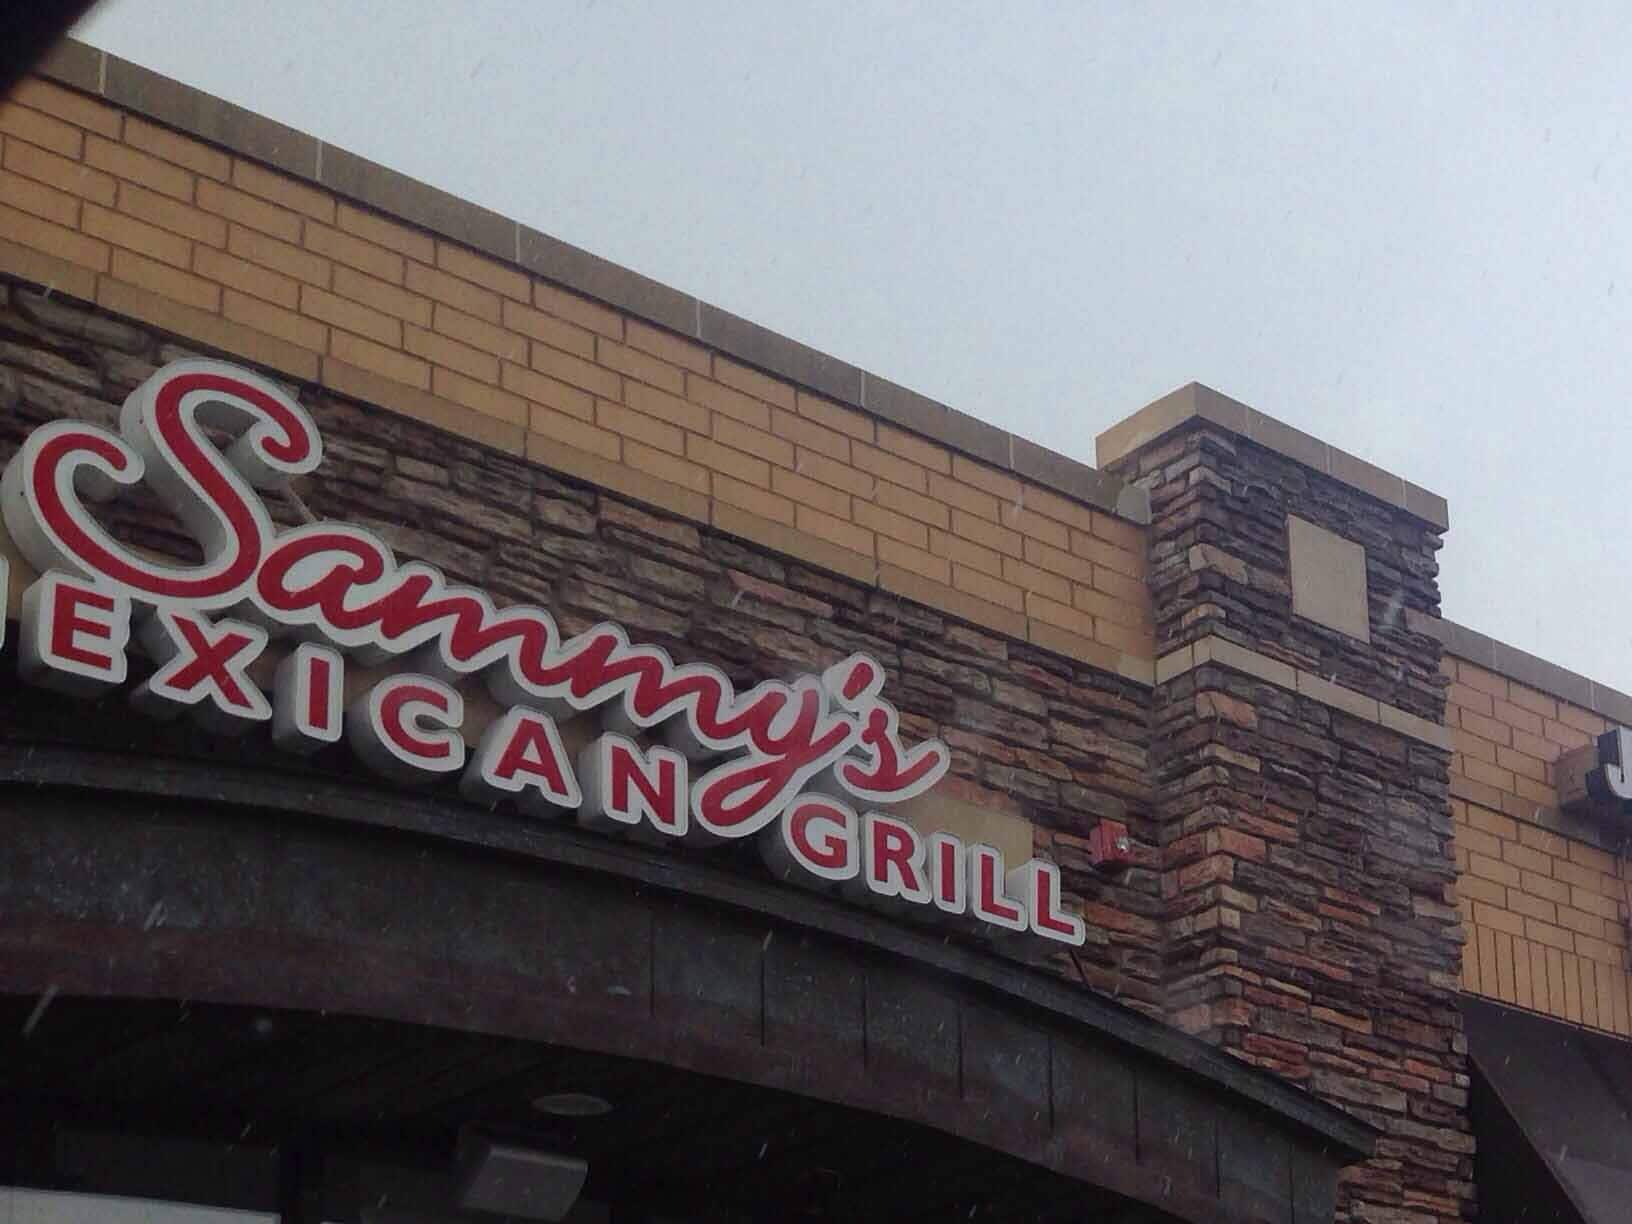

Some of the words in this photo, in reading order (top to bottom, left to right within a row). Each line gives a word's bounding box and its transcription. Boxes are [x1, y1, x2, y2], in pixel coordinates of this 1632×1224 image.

[0, 556, 688, 837] EXICAN
[786, 793, 1086, 946] GRILL
[4, 358, 950, 839] Sammy's
